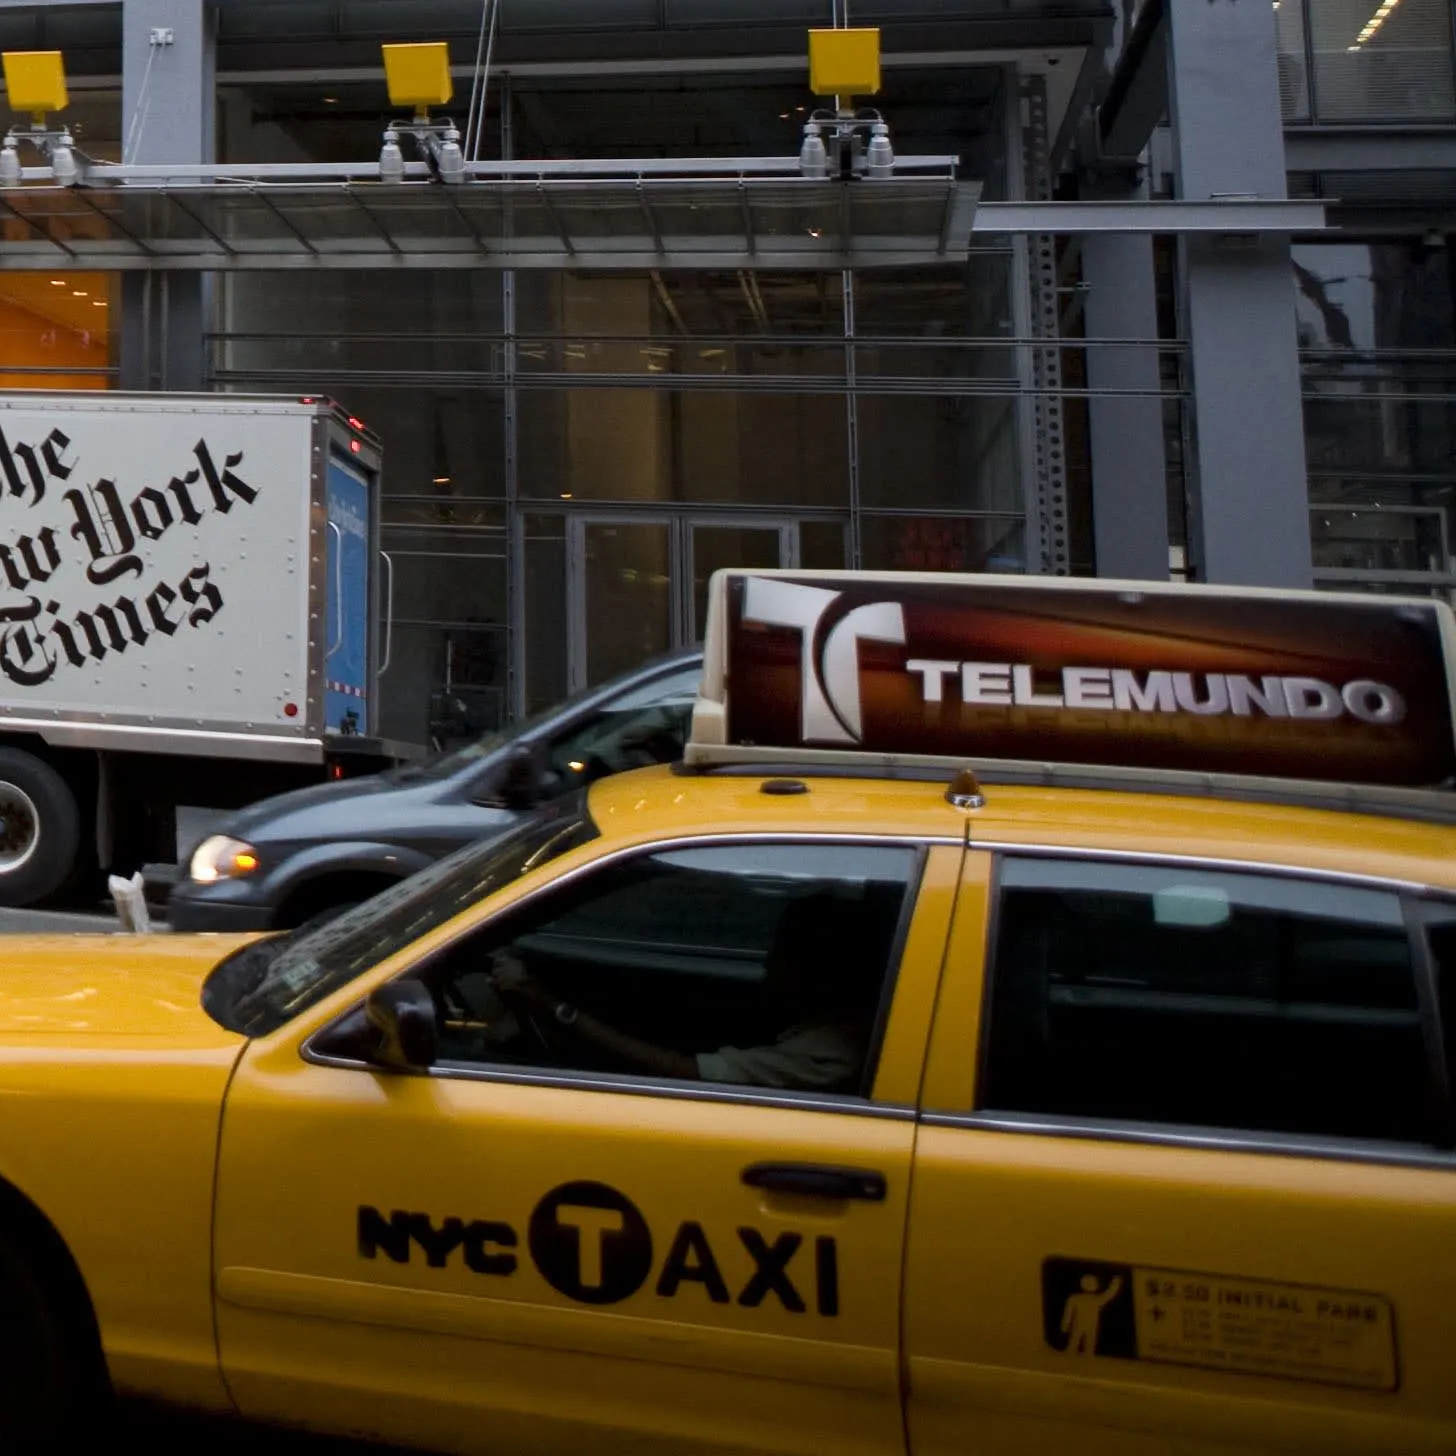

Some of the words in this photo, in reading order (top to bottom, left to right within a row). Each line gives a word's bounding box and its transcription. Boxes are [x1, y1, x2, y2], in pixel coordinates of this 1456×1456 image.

[62, 437, 262, 585] York
[905, 658, 1406, 725] TELEMUNDO
[357, 1204, 518, 1276] NYC
[528, 1179, 839, 1317] TAXI
